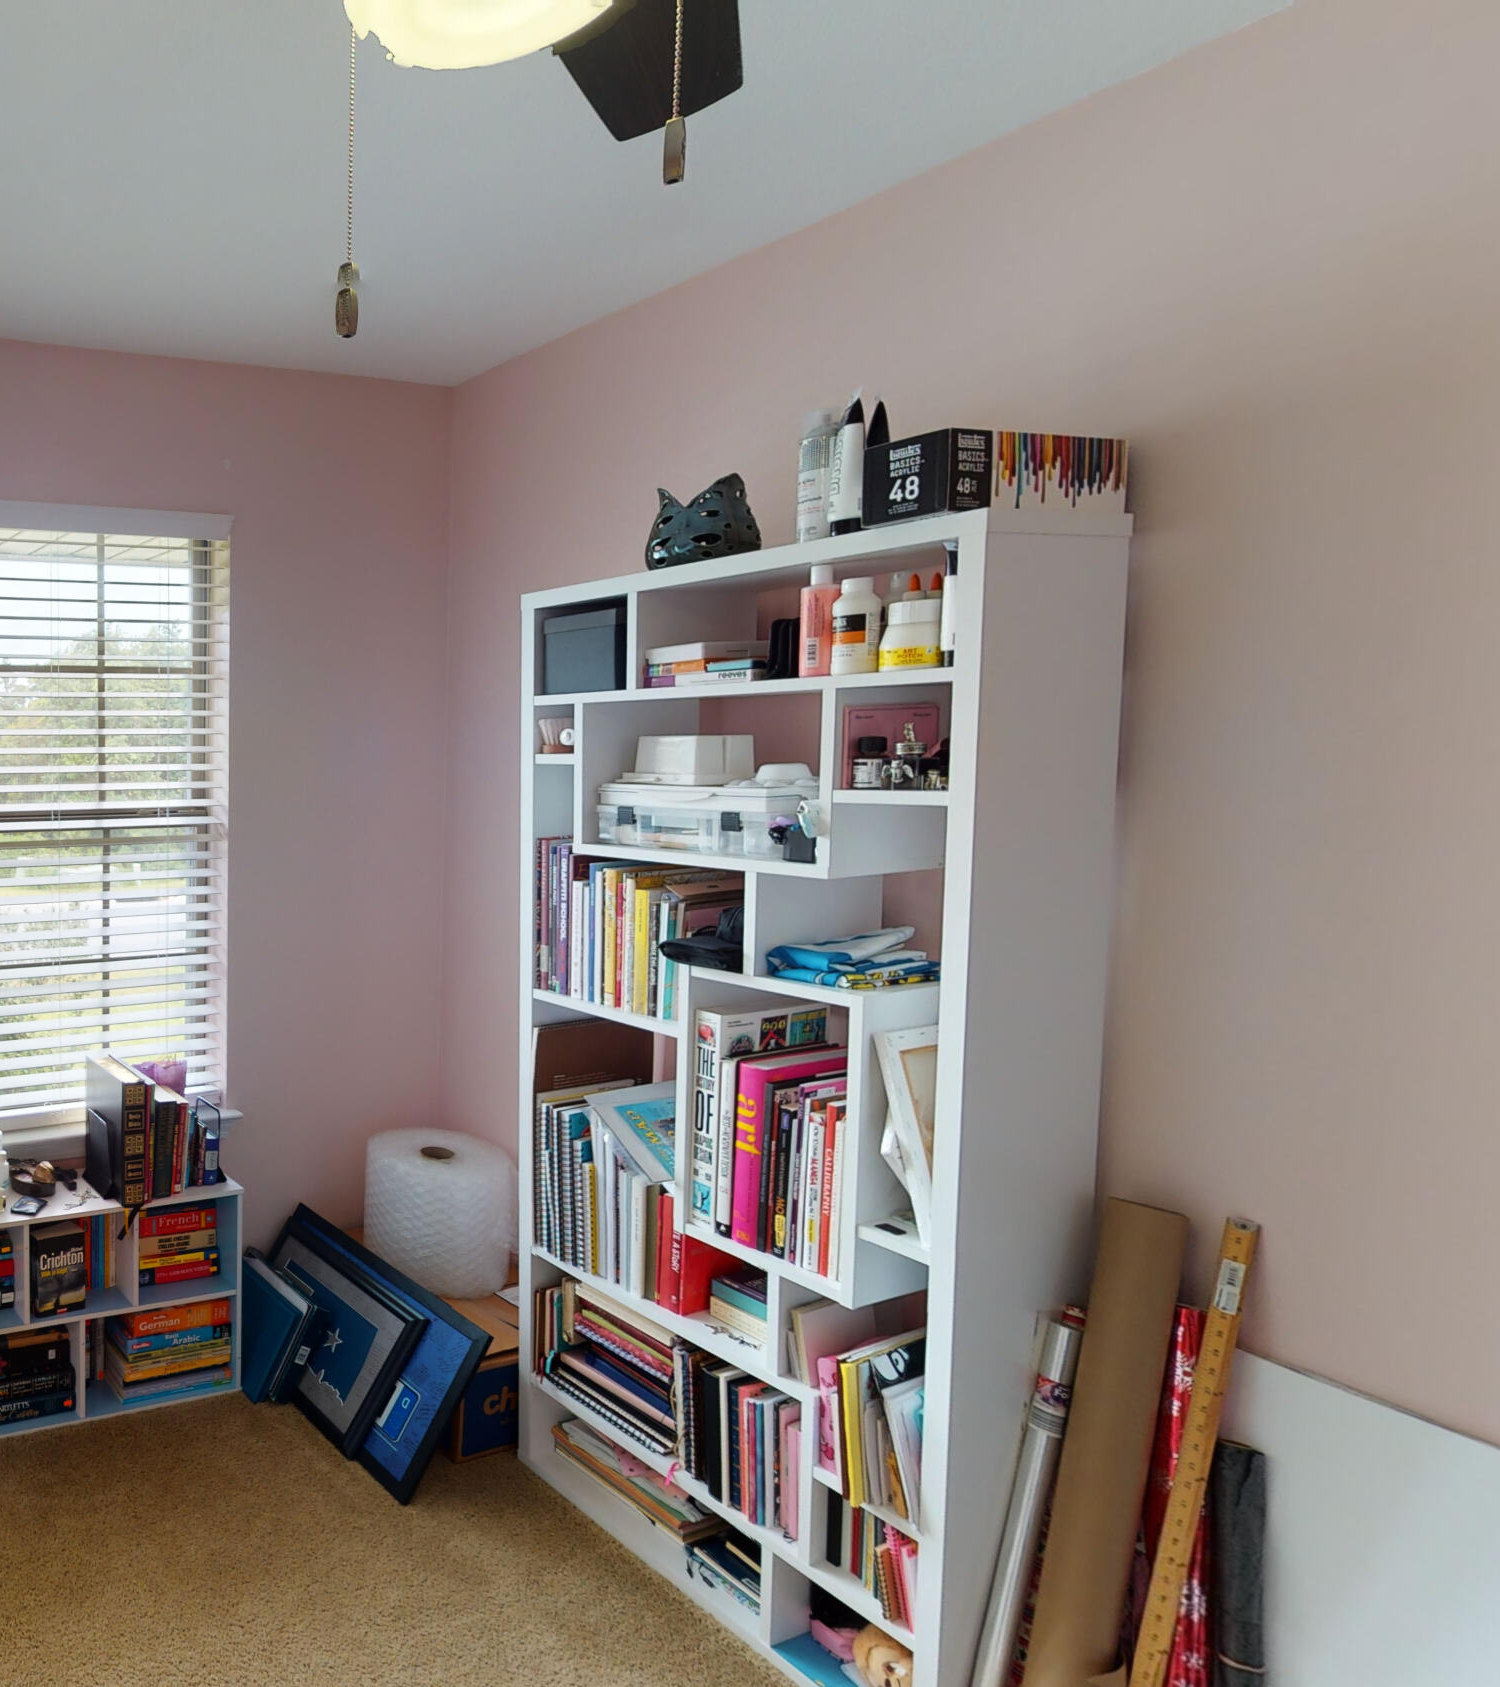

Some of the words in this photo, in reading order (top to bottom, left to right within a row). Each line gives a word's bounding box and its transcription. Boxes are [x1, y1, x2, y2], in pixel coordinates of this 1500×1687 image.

[890, 457, 921, 470] BASICS
[958, 450, 985, 461] BASICS
[890, 466, 920, 478] ACRYLIC
[958, 462, 985, 473] ACRYLIC
[889, 476, 920, 502] 48
[956, 477, 971, 494] 48
[718, 670, 747, 680] reeves
[559, 858, 567, 900] GRAFFITI
[559, 902, 567, 941] SCHOOL
[697, 1046, 717, 1079] THE
[695, 1090, 715, 1135] OF
[736, 1094, 762, 1155] art
[809, 1158, 819, 1186] MANGA
[821, 1148, 833, 1216] CALLIGRAPHY
[159, 1213, 200, 1227] French
[40, 1251, 84, 1270] Crichton
[139, 1318, 181, 1331] German
[172, 1335, 200, 1346] Arabic
[483, 1384, 518, 1416] ch
